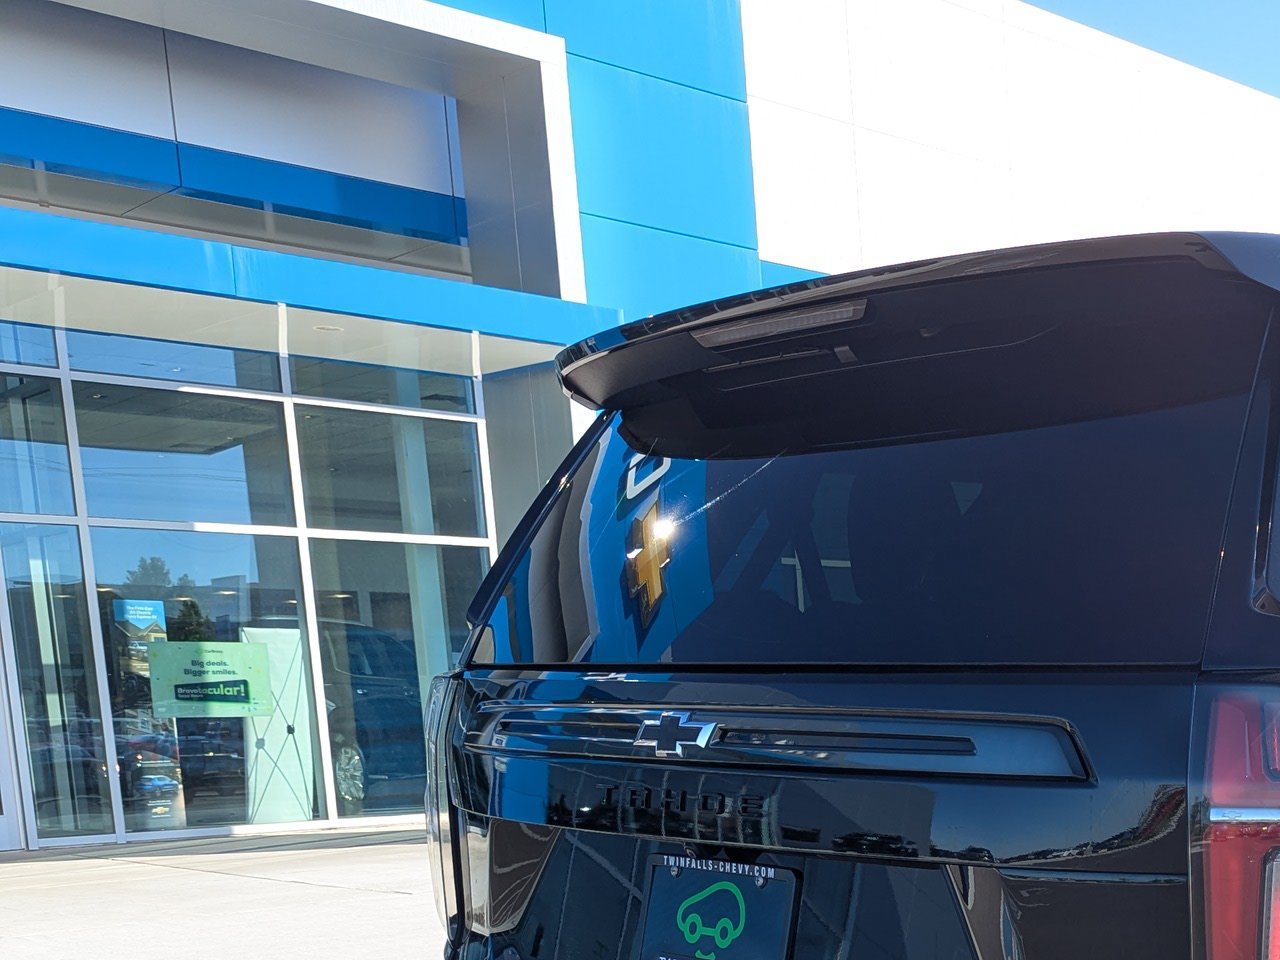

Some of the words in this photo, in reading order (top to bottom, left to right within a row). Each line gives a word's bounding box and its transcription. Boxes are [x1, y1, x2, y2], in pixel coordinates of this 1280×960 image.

[191, 660, 204, 668] Big
[184, 669, 210, 677] Bigger
[596, 784, 765, 819] TAHOE
[663, 855, 775, 879] TWINFALLS-CHEVY.COM
